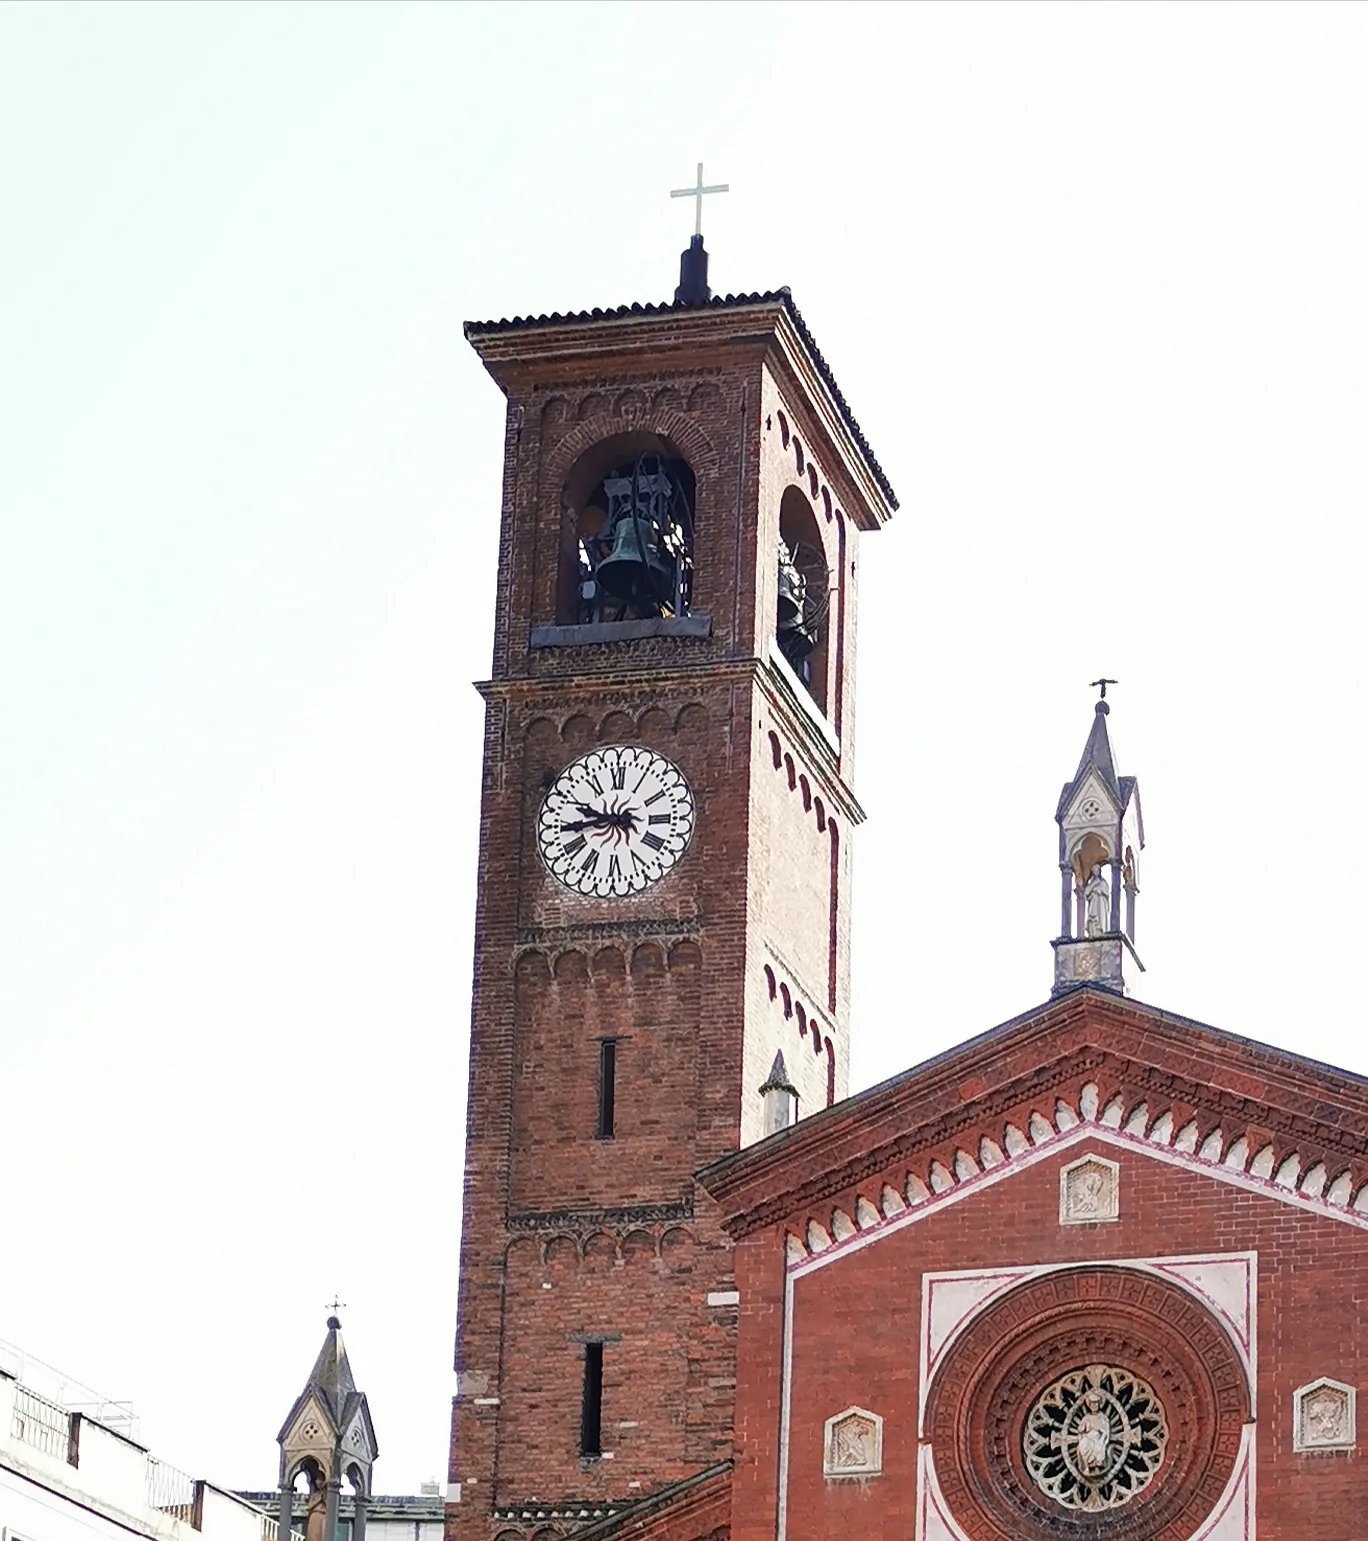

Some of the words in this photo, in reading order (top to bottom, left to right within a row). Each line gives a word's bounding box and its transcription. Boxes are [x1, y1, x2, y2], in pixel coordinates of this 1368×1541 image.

[585, 774, 604, 798] XI
[610, 767, 626, 790] XII
[644, 789, 666, 807] II
[609, 854, 622, 877] VI
